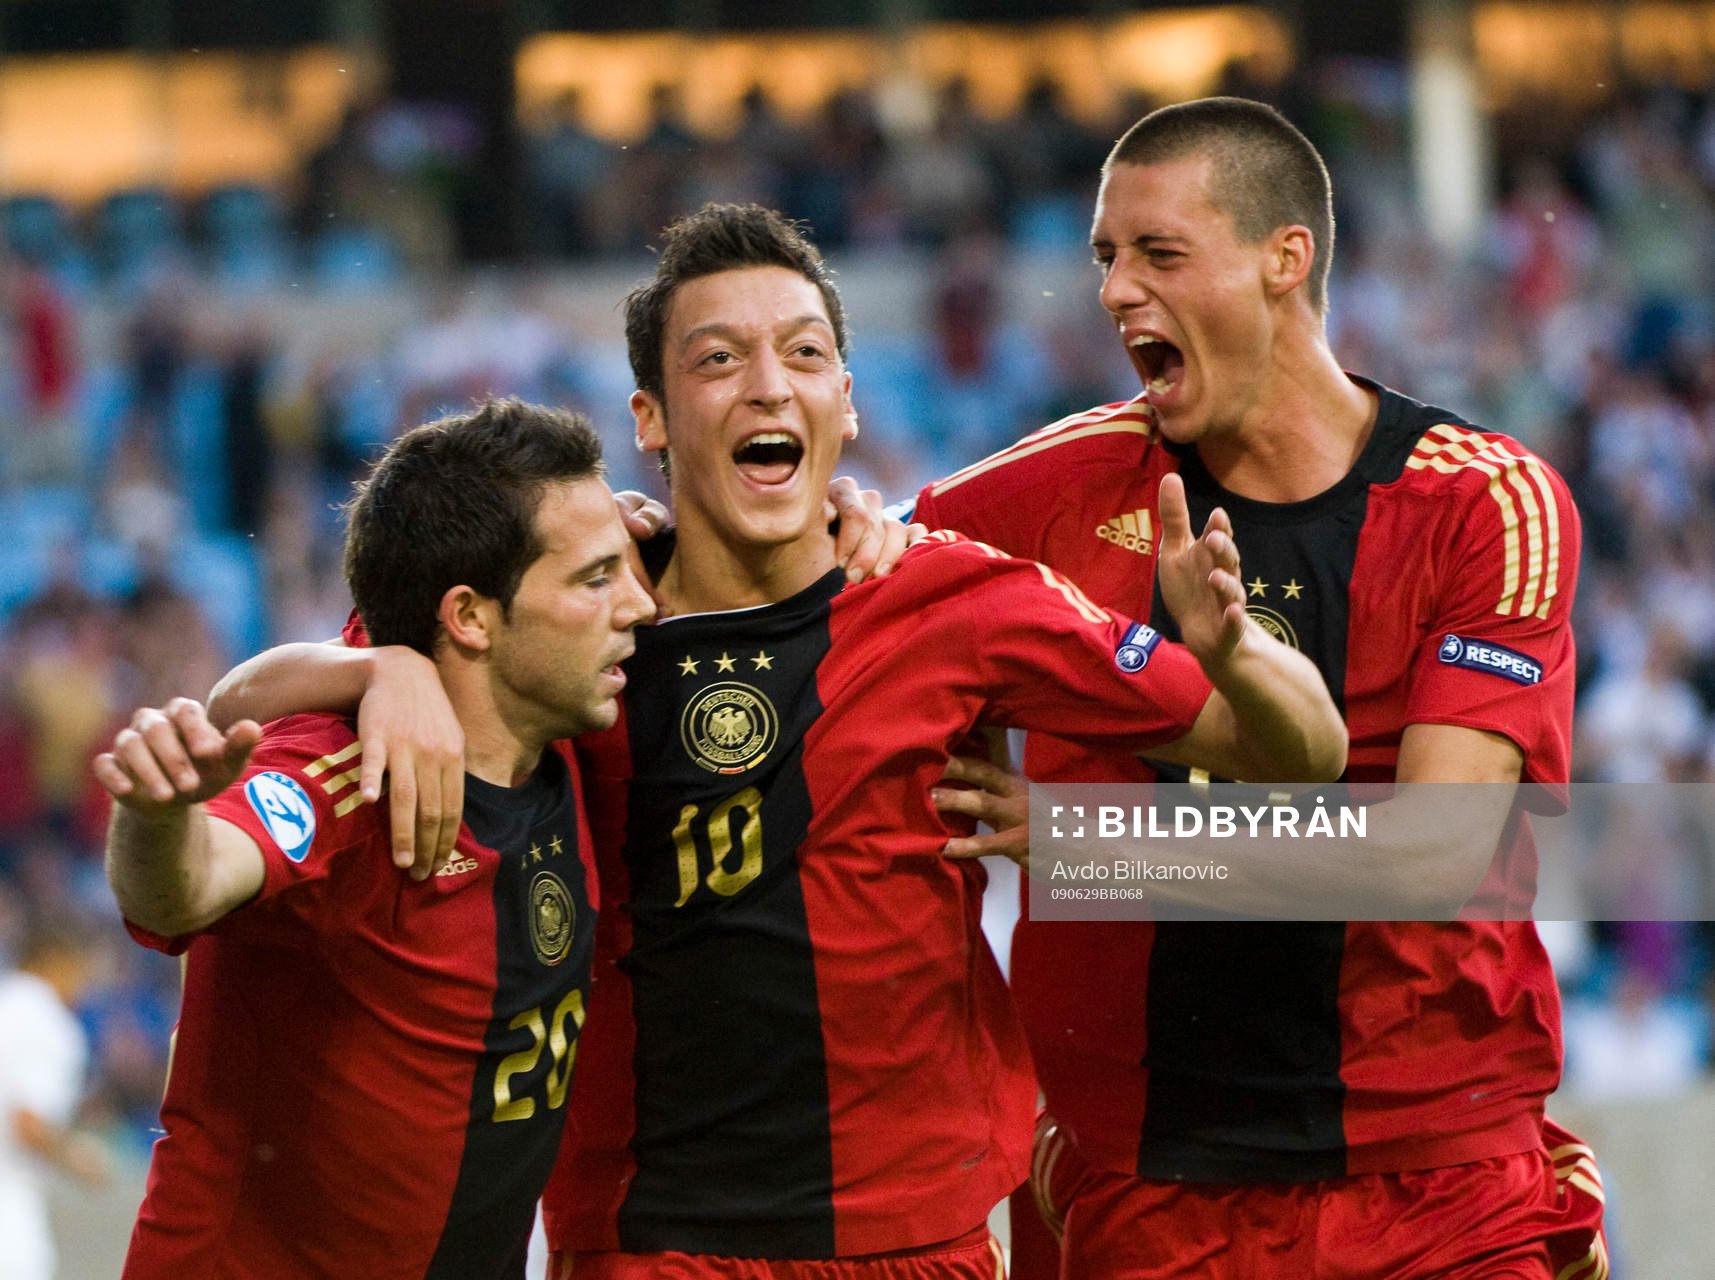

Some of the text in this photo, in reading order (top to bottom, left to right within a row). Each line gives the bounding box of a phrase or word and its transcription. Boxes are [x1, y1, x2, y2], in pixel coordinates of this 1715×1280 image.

[1095, 525, 1152, 555] adida
[1466, 645, 1541, 683] RESPECT
[671, 786, 763, 908] 10
[492, 988, 586, 1123] 20
